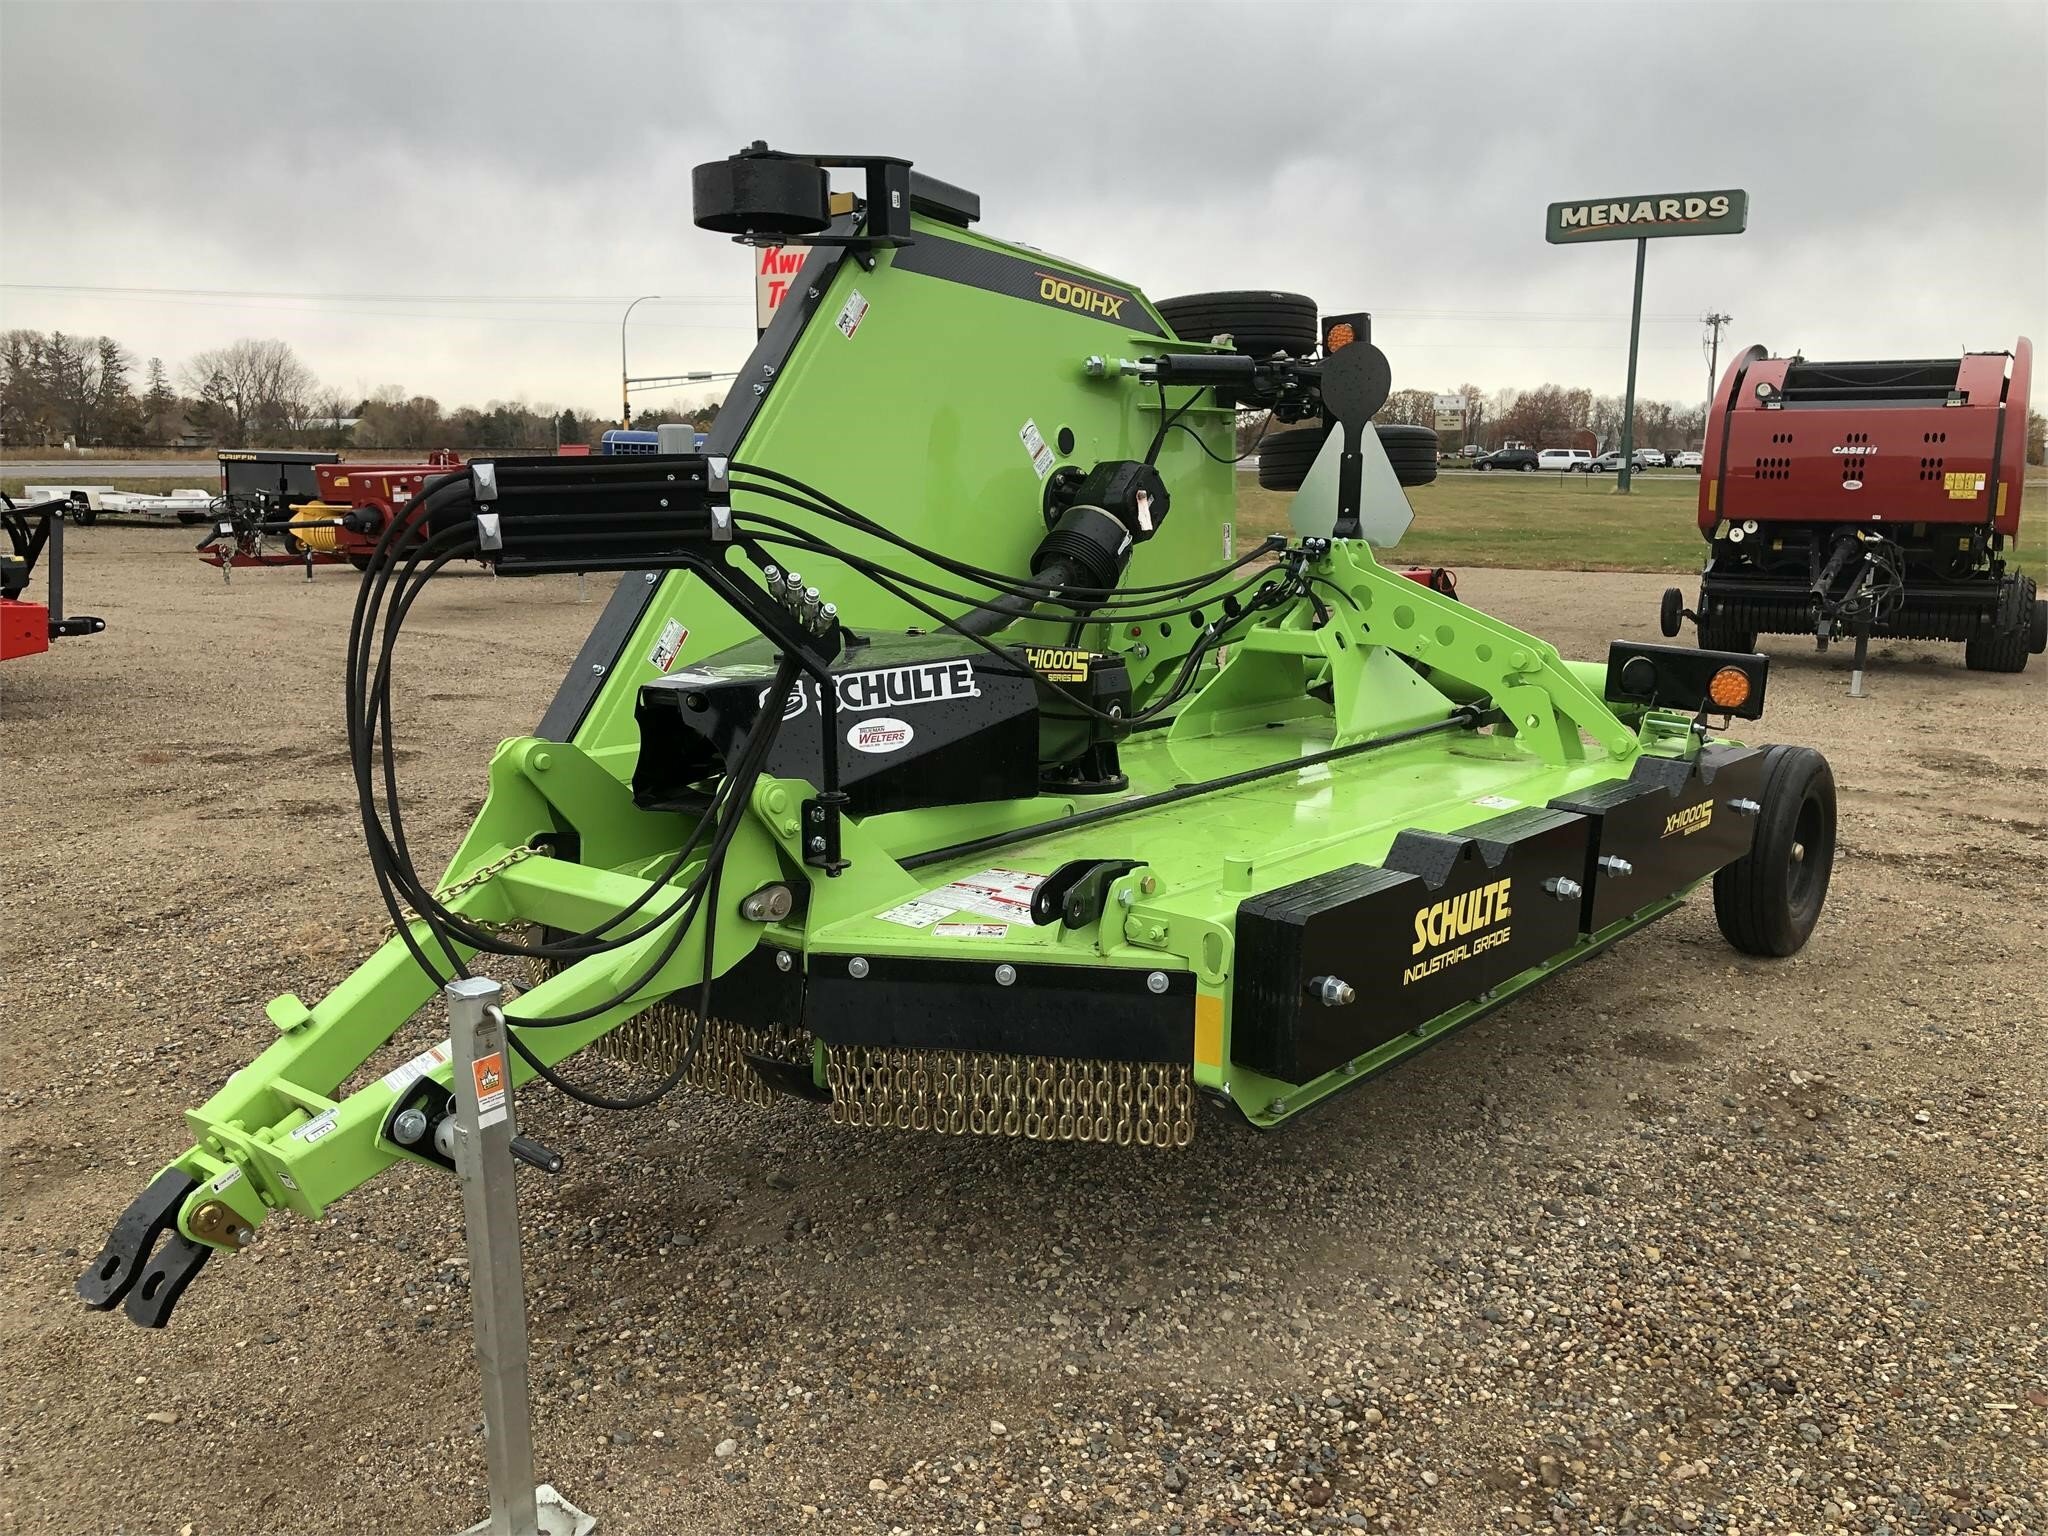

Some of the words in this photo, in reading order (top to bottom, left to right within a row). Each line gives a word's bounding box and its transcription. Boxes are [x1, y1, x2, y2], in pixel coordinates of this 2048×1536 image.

[1560, 196, 1729, 228] MENARDS
[1832, 446, 1865, 454] CASE
[1026, 648, 1073, 669] H1000
[1047, 673, 1072, 682] SERIES
[859, 733, 905, 744] WELTERS
[1412, 877, 1511, 956] SCHULTE
[1403, 944, 1472, 986] INDUSTRIAL
[1473, 926, 1511, 955] GRADE
